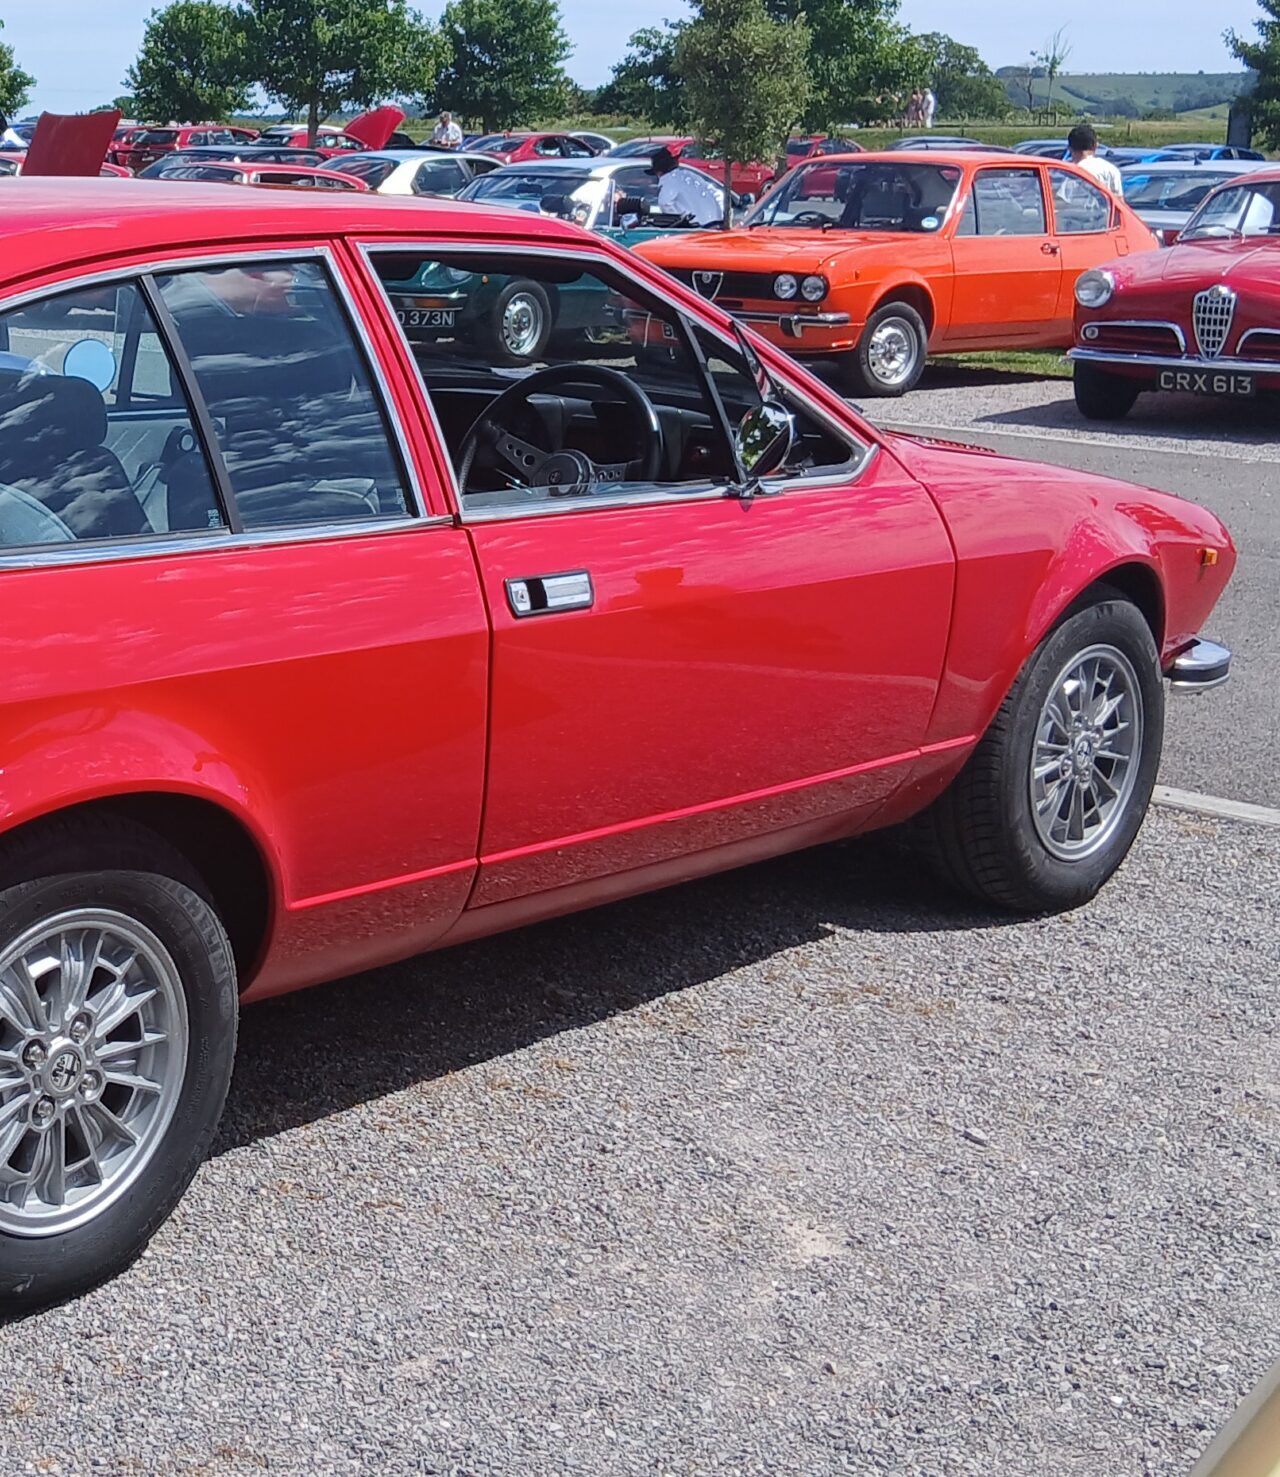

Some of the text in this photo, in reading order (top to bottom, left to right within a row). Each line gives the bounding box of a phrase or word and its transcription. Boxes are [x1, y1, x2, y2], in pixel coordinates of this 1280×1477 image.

[410, 311, 453, 325] 373N
[1160, 371, 1252, 394] CRX 613
